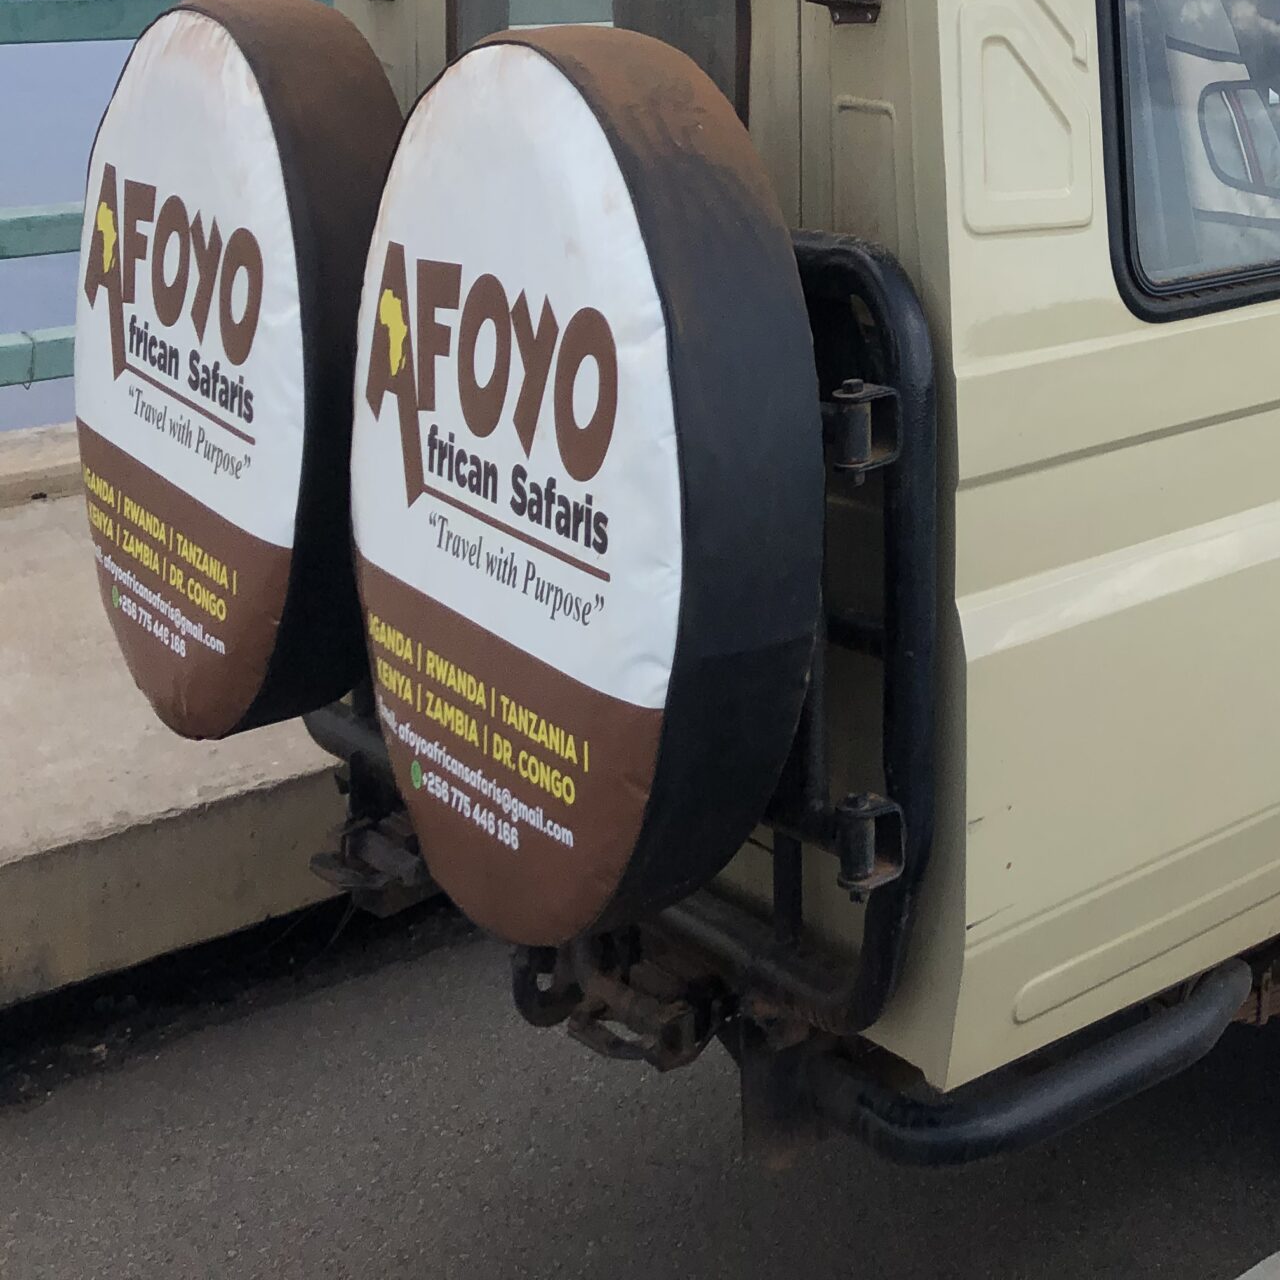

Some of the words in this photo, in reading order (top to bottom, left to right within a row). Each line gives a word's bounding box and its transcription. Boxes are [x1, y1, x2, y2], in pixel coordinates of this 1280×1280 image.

[84, 161, 264, 382] AFOYO
[187, 348, 254, 424] Safaris
[366, 240, 618, 509] AFOYO
[169, 413, 193, 449] with
[123, 495, 166, 545] RWANDA
[176, 532, 229, 590] TANZANIA
[509, 463, 609, 555] Safaris
[88, 501, 114, 541] KENYA
[122, 530, 160, 575] ZAMBIA
[169, 564, 186, 595] DR.
[187, 578, 227, 621] CONGO
[486, 546, 517, 589] with
[138, 606, 153, 633] 775
[376, 656, 413, 706] KENYA
[425, 690, 479, 748] ZAMBIA
[492, 732, 516, 771] DR.
[518, 749, 576, 806] CONGO
[426, 649, 487, 710] RWANDA
[500, 694, 578, 765] TANZANIA
[399, 721, 574, 848] afoyoafricansafaris@gmail.com
[450, 786, 472, 819] 775
[472, 803, 496, 836] 446
[497, 818, 520, 851] 166
